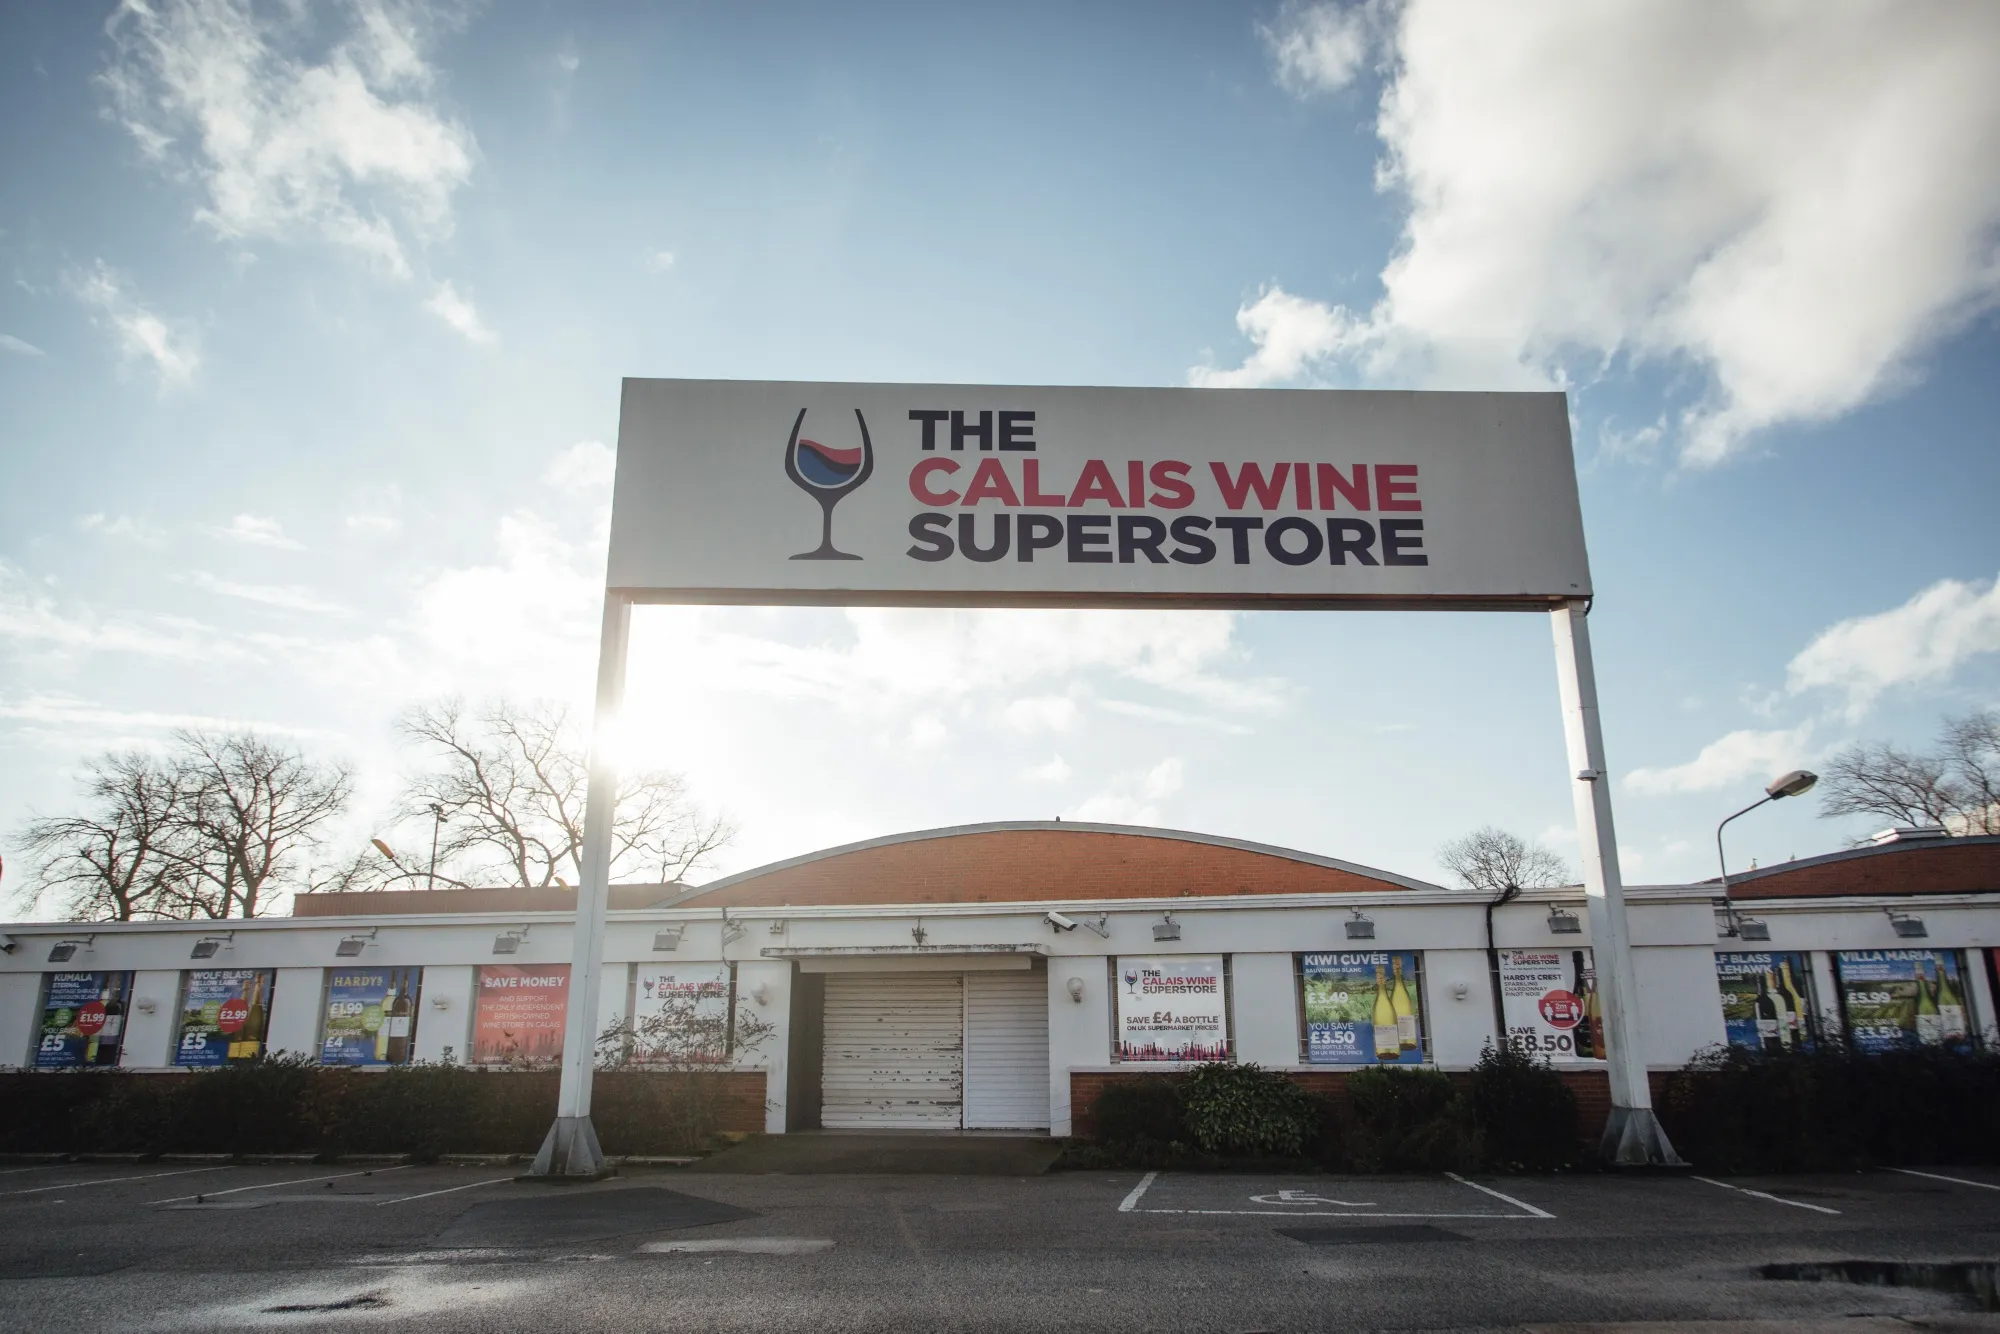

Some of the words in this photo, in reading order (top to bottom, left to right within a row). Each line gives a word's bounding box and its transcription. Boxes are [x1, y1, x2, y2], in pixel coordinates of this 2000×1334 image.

[909, 410, 1036, 452] THE
[908, 457, 1195, 511] CALAIS
[1209, 461, 1422, 512] WINE
[905, 512, 1428, 567] SUPERSTORE
[1304, 955, 1338, 965] KIWI
[1341, 951, 1389, 965] CUVÉE
[1731, 954, 1772, 963] BLASS
[1839, 952, 1884, 962] VILLA
[1885, 951, 1934, 960] MARIA
[54, 973, 92, 982] KUMALA
[193, 971, 220, 979] WOLF
[223, 971, 253, 979] BLASS
[1142, 977, 1183, 985] CALAIS
[1186, 976, 1216, 985] WINE
[334, 976, 383, 986] HARDYS
[485, 977, 517, 987] SAVE
[520, 977, 565, 987] MONEY
[1142, 985, 1217, 994] SUPERSTORE
[1307, 991, 1349, 1004] £3.49
[1847, 992, 1891, 1004] £5.99
[330, 1003, 363, 1014] £1.99
[80, 1013, 105, 1023] £1.99
[220, 1010, 248, 1020] £2.99
[1126, 1016, 1150, 1024] SAVE
[1153, 1011, 1172, 1024] £4
[1509, 1027, 1536, 1035] SAVE
[40, 1034, 65, 1051] £5
[182, 1033, 207, 1049] £5
[326, 1036, 343, 1047] £4
[1310, 1031, 1355, 1044] £3.50
[1512, 1035, 1572, 1051] £8.50
